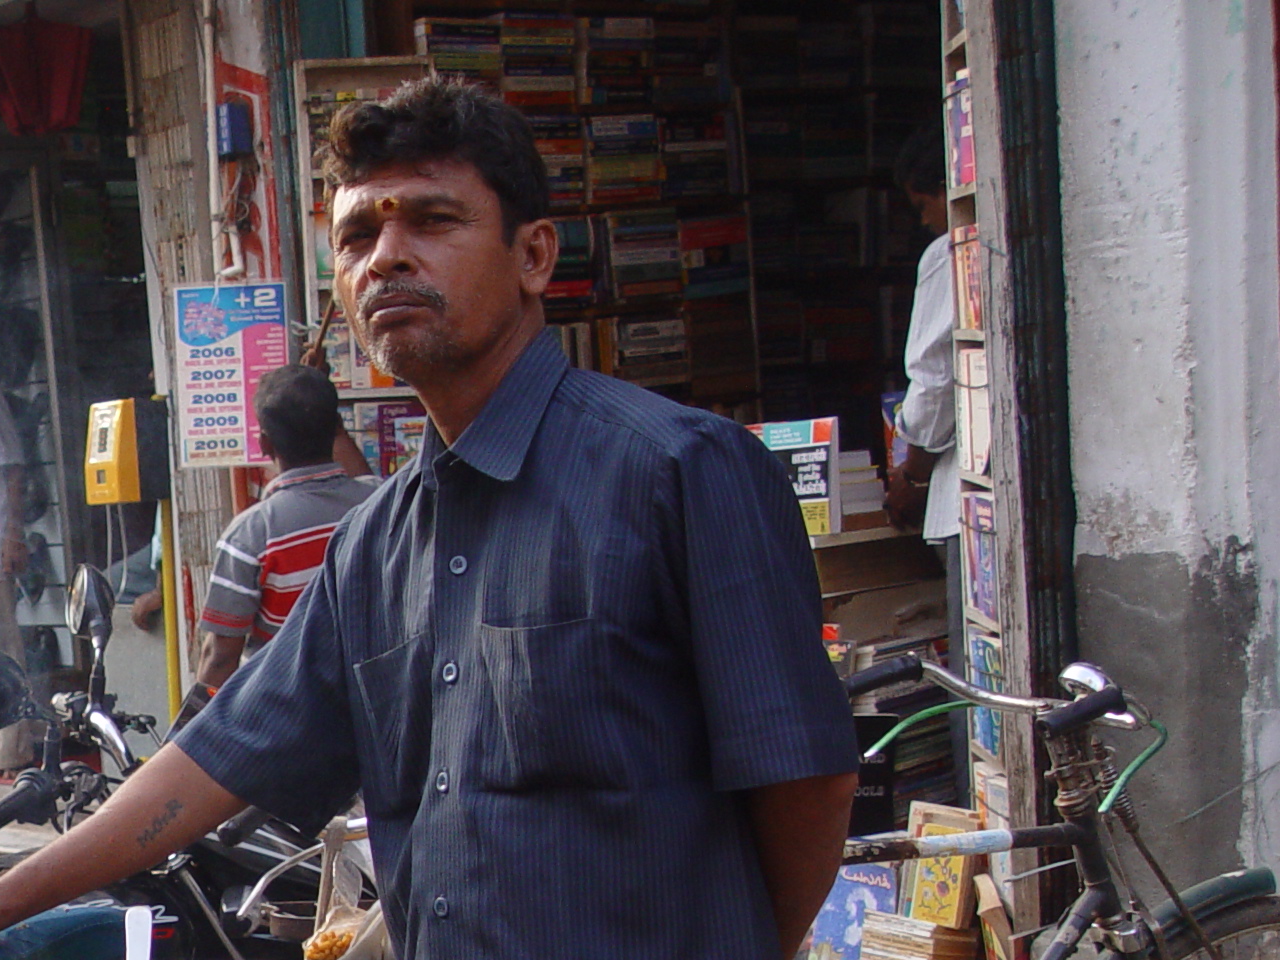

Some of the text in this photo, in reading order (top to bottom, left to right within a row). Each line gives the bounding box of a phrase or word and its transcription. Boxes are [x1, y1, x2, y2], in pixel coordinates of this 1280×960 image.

[234, 288, 277, 308] +2
[189, 347, 235, 359] 2006
[191, 369, 236, 381] 2007
[192, 393, 237, 404] 2008
[193, 416, 239, 427] 2009
[194, 438, 238, 450] 2010
